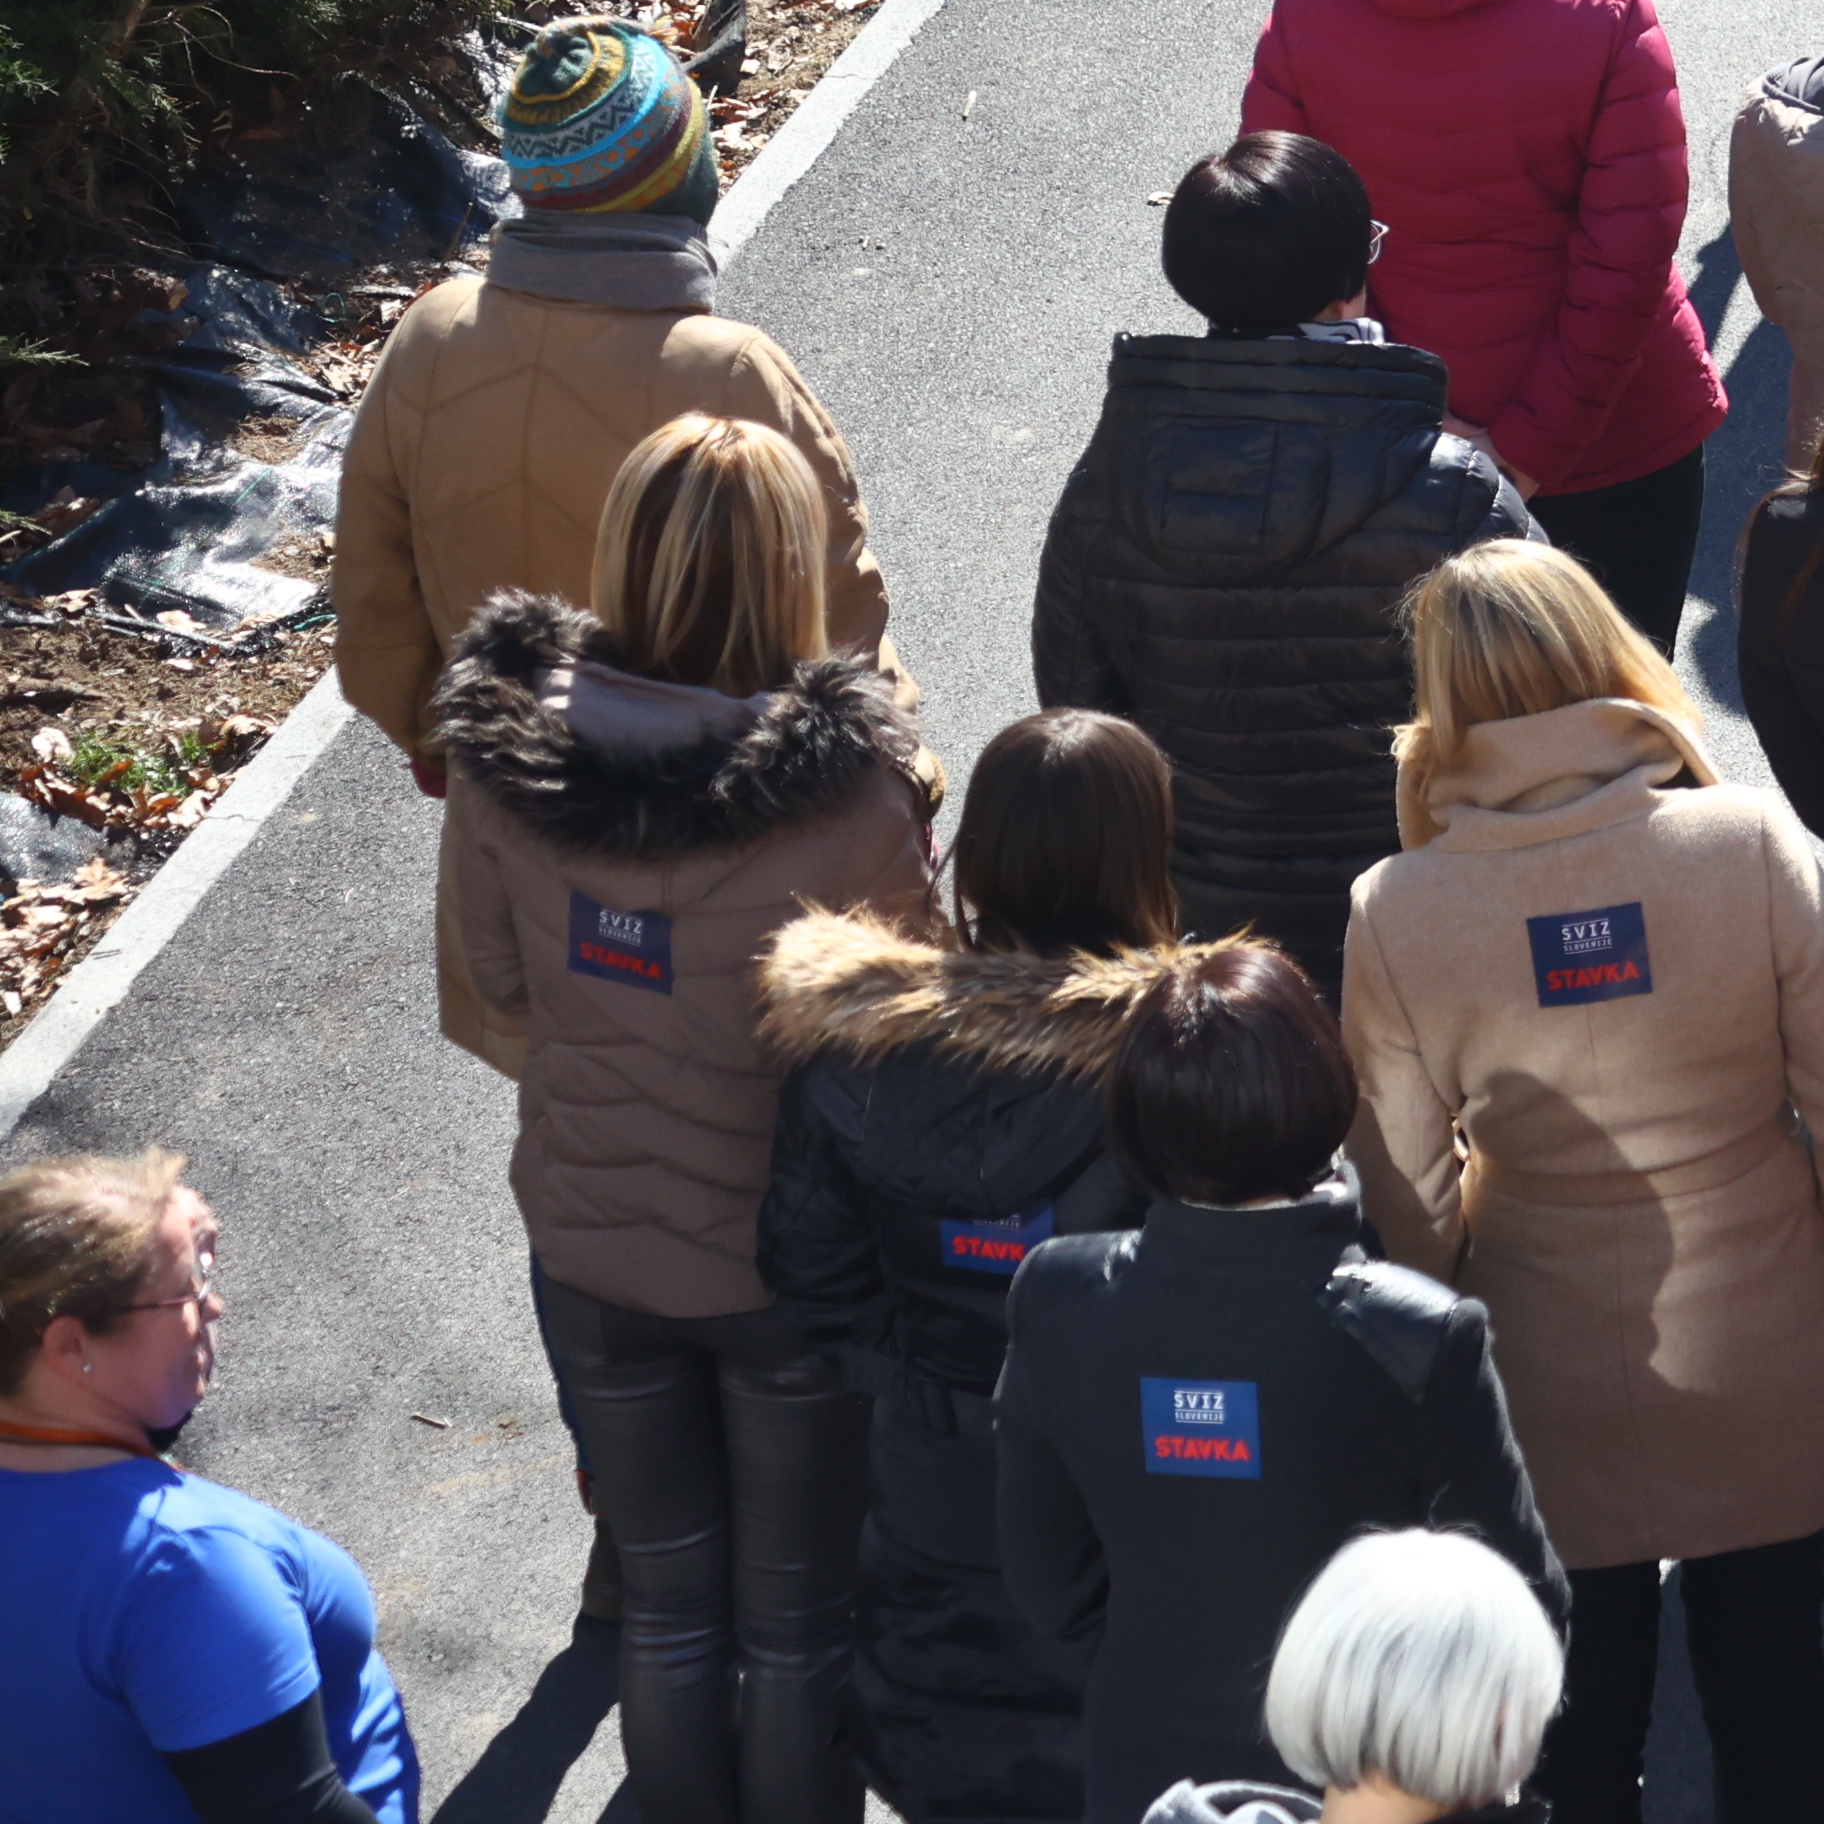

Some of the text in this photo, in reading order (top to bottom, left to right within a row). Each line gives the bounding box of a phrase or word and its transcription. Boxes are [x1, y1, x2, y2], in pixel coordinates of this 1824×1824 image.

[599, 911, 642, 934] SVIZ
[1561, 921, 1611, 941] SVIZ
[1563, 938, 1612, 952] SLOVENIJE
[579, 941, 663, 980] STAVKA
[1546, 960, 1640, 991] STAVKA
[952, 1234, 1026, 1262] STAVK
[1174, 1393, 1224, 1410] SVIZ
[1154, 1435, 1251, 1462] STAVKA
